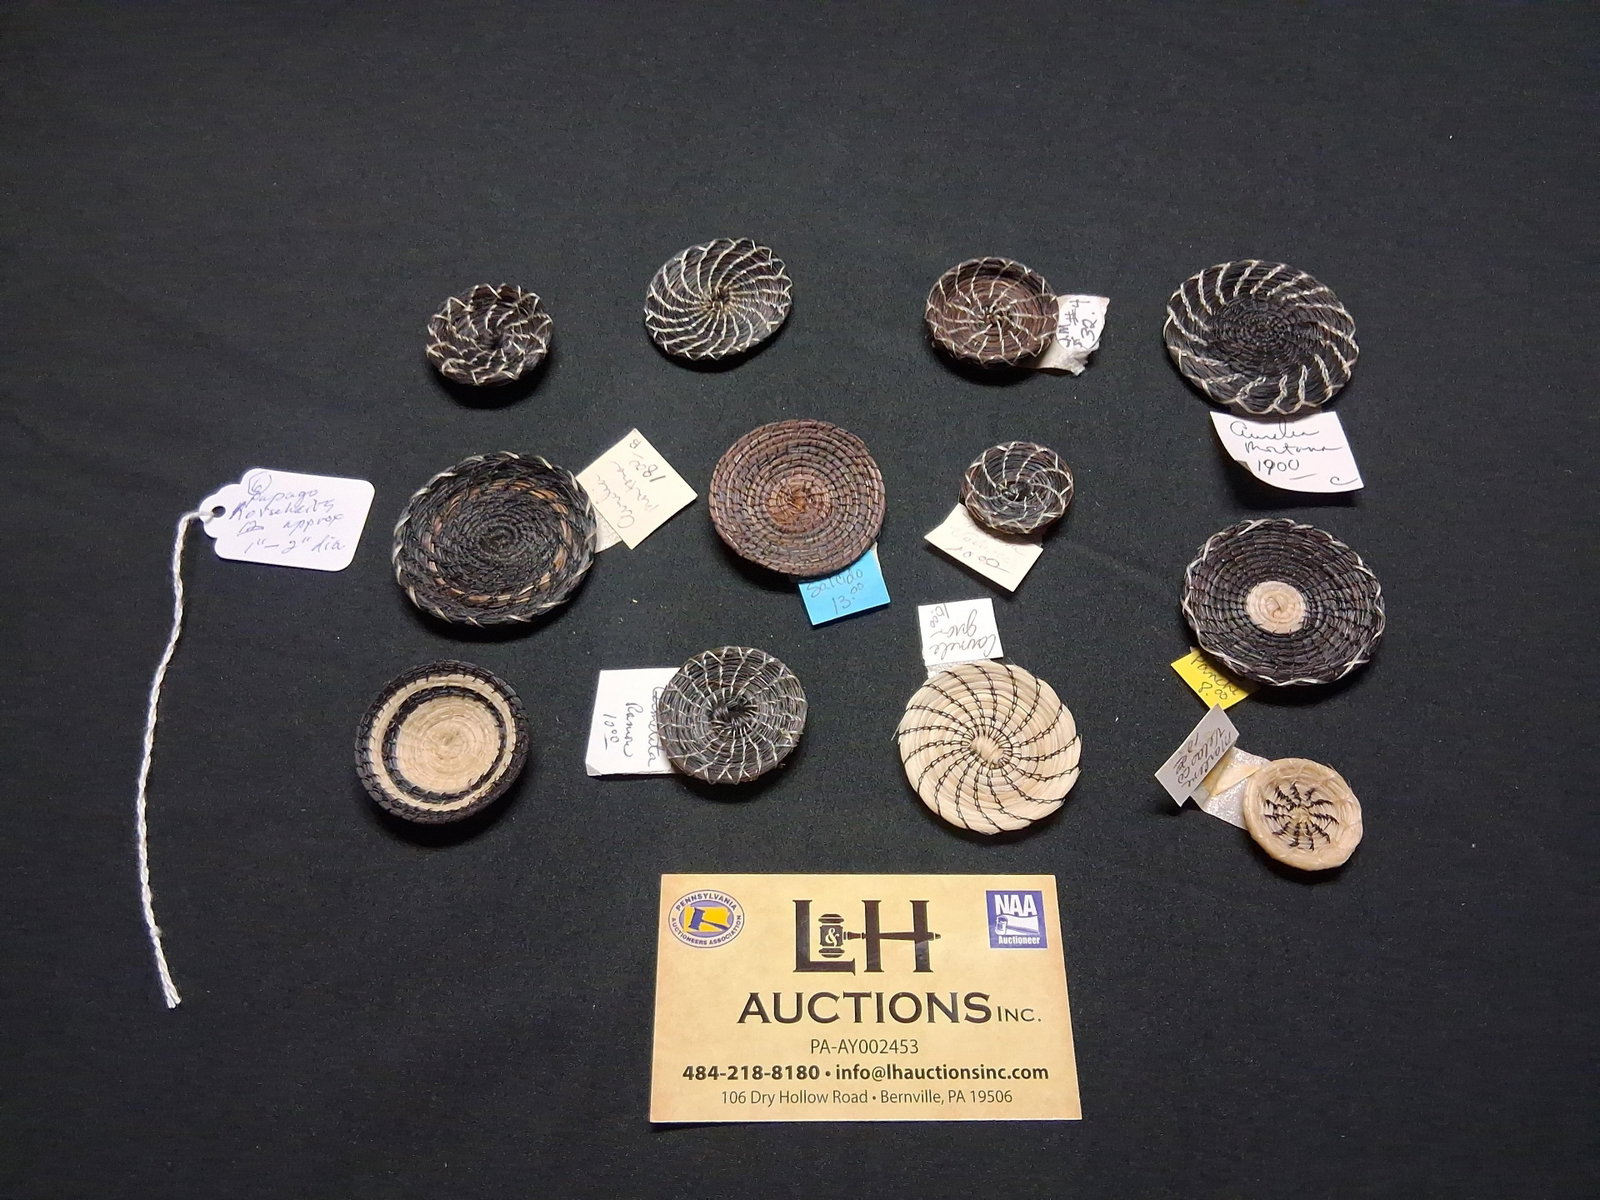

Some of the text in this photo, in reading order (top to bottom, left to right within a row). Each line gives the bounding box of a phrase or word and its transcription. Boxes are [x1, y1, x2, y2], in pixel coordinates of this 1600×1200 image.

[675, 892, 738, 912] PENNSYLVANIA
[994, 894, 1038, 917] NAA
[670, 914, 742, 946] AUCTIONEERS ASSOCIATION
[998, 935, 1041, 945] Auctioneer
[737, 991, 993, 1025] AUCTIONS
[810, 1038, 920, 1055] PA-AY002453
[682, 1063, 1049, 1082] 484-218-8180 info@lhauctionsinc.com
[721, 1089, 1014, 1108] 106 Dry Hollow Road Bernville, PA 19506
